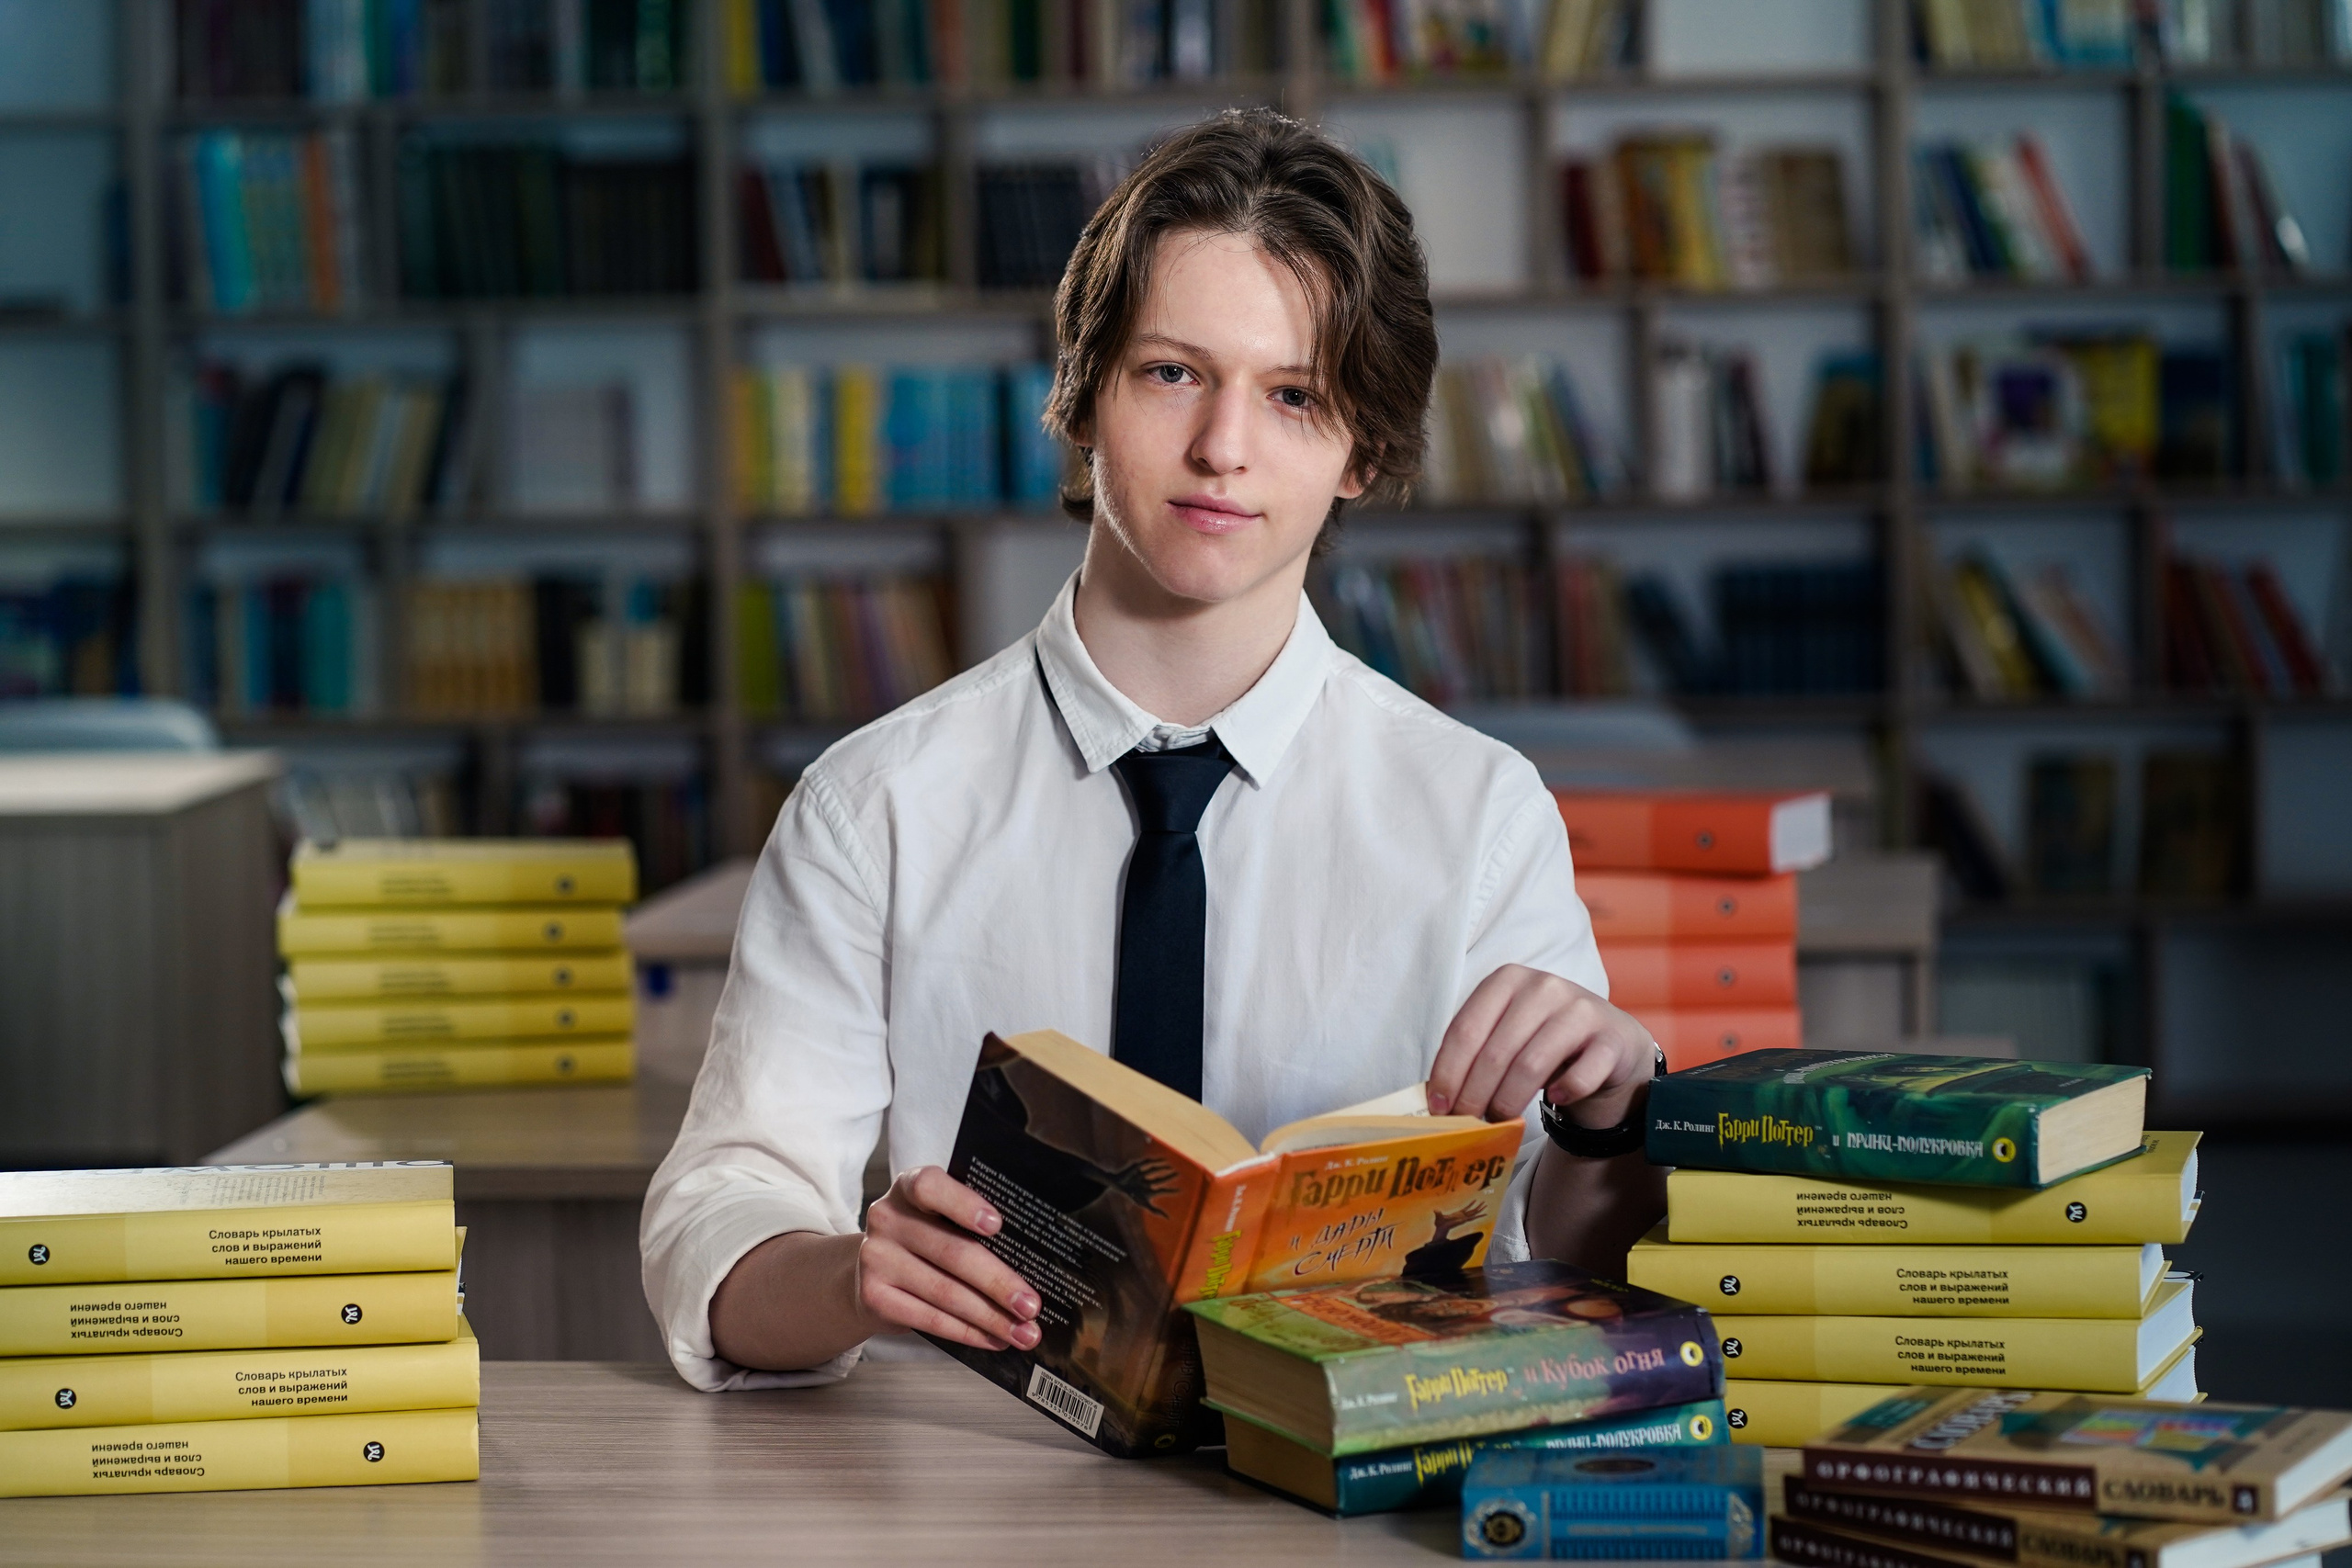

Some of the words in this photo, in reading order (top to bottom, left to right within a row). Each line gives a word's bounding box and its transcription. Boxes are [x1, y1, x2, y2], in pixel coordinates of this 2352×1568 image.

[1656, 1119, 1672, 1131] Дж.
[1673, 1121, 1682, 1131] К.
[1683, 1122, 1715, 1134] Ролинг
[1718, 1112, 1759, 1152] Гарри
[1761, 1114, 1814, 1147] Поттер
[1289, 1168, 1387, 1218] Гарри
[1797, 1191, 1847, 1201] времени
[972, 1156, 997, 1177] Гарри
[998, 1173, 1034, 1200] Поттера
[1084, 1228, 1128, 1258] страшное
[1797, 1204, 1864, 1215] выражений
[1797, 1218, 1855, 1226] крылатых
[1858, 1218, 1908, 1229] Словарь
[209, 1230, 259, 1240] Словарь
[263, 1228, 321, 1239] крылатых
[212, 1245, 240, 1253] слов
[253, 1239, 321, 1252] выражений
[226, 1257, 267, 1265] нашего
[271, 1255, 322, 1265] времени
[1049, 1262, 1096, 1295] предстают
[1896, 1269, 1947, 1280] Словарь
[1950, 1271, 2008, 1280] крылатых
[1940, 1283, 2008, 1293] выражений
[71, 1301, 121, 1312] времени
[124, 1302, 166, 1310] нашего
[71, 1314, 139, 1327] выражений
[71, 1327, 130, 1338] крылатых
[132, 1327, 183, 1337] Словарь
[1895, 1336, 1944, 1348] Словарь
[1947, 1339, 2005, 1349] крылатых
[1898, 1351, 1925, 1359] слов
[1938, 1353, 2005, 1362] выражений
[235, 1372, 286, 1382] Словарь
[288, 1369, 347, 1381] крылатых
[1540, 1353, 1610, 1391] Кубок
[1955, 1367, 2006, 1375] времени
[279, 1381, 347, 1393] выражений
[252, 1398, 293, 1406] нашего
[297, 1395, 347, 1405] времени
[92, 1441, 142, 1452] времени
[146, 1441, 188, 1450] нашего
[92, 1454, 161, 1467] выражений
[175, 1454, 201, 1462] слов
[93, 1468, 151, 1478] крылатых
[154, 1467, 205, 1476] Словарь
[1815, 1460, 2092, 1498] ОРФОГРАФИЧЕСКИЙ
[2103, 1478, 2227, 1508] СЛОВАРЬ
